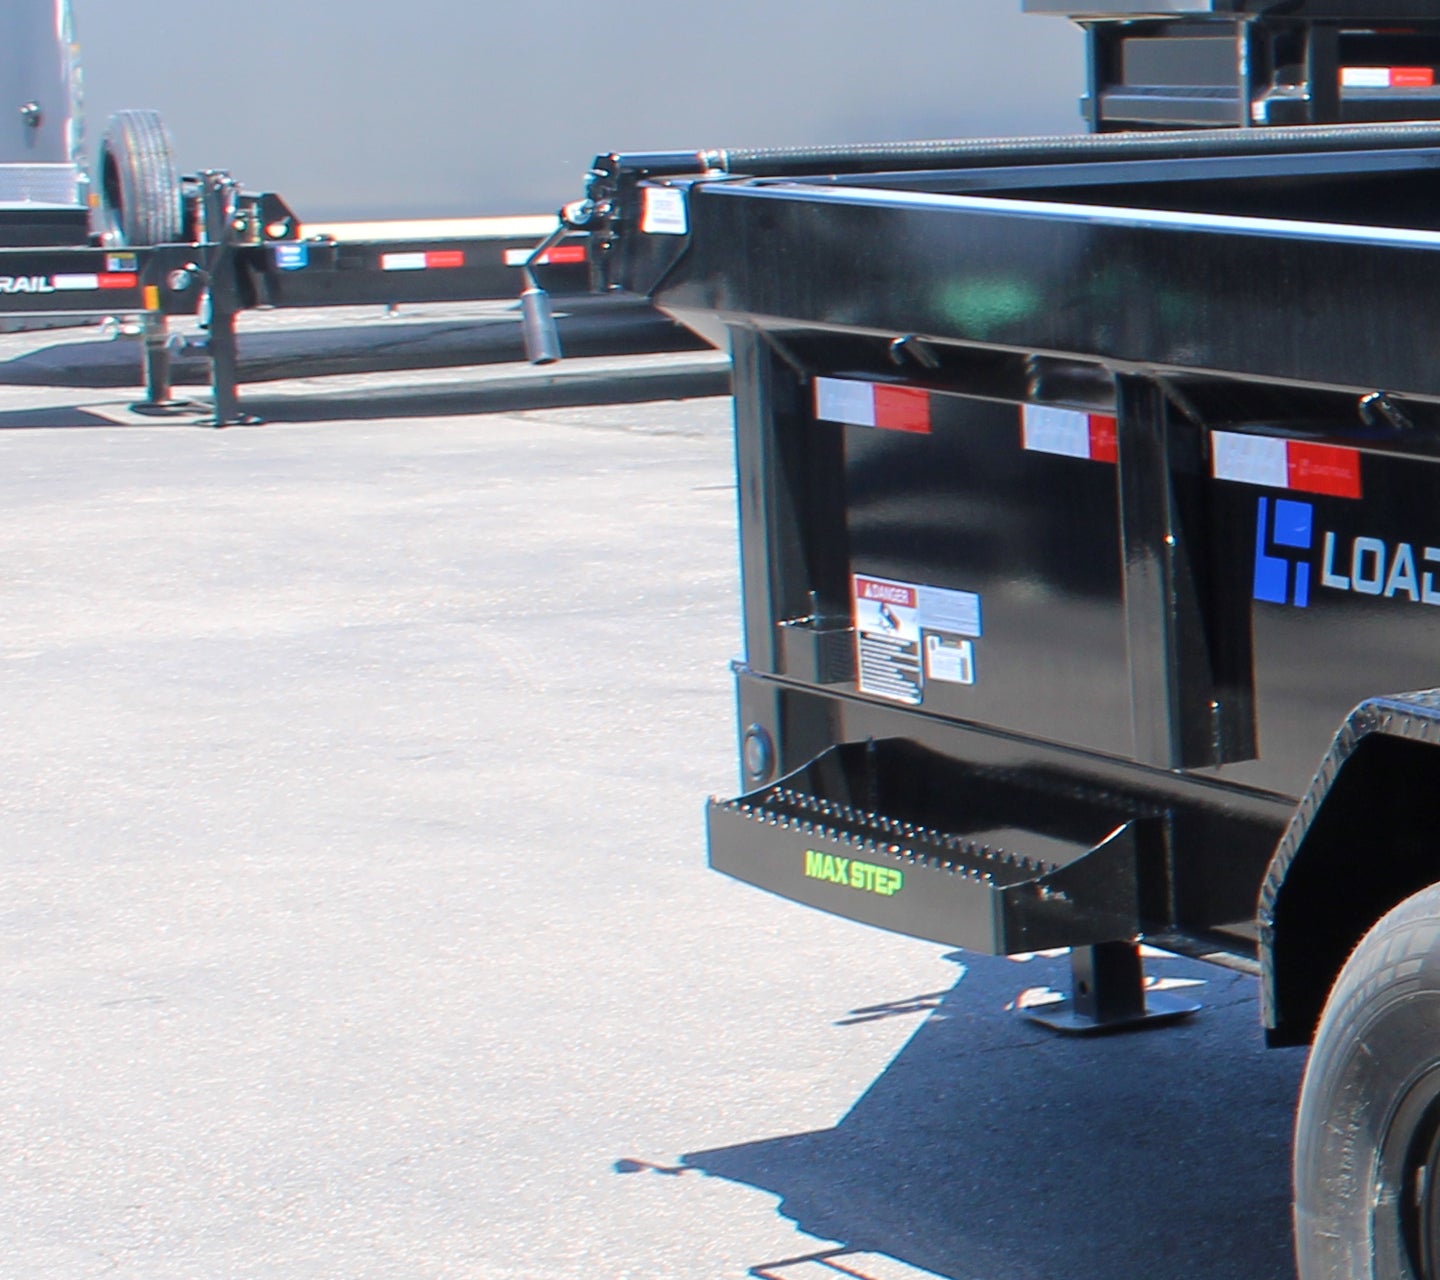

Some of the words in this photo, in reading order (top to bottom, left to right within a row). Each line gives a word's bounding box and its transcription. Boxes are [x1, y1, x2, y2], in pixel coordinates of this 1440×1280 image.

[871, 583, 910, 604] DANGER
[805, 850, 849, 885] MAX
[850, 860, 904, 896] STEP
